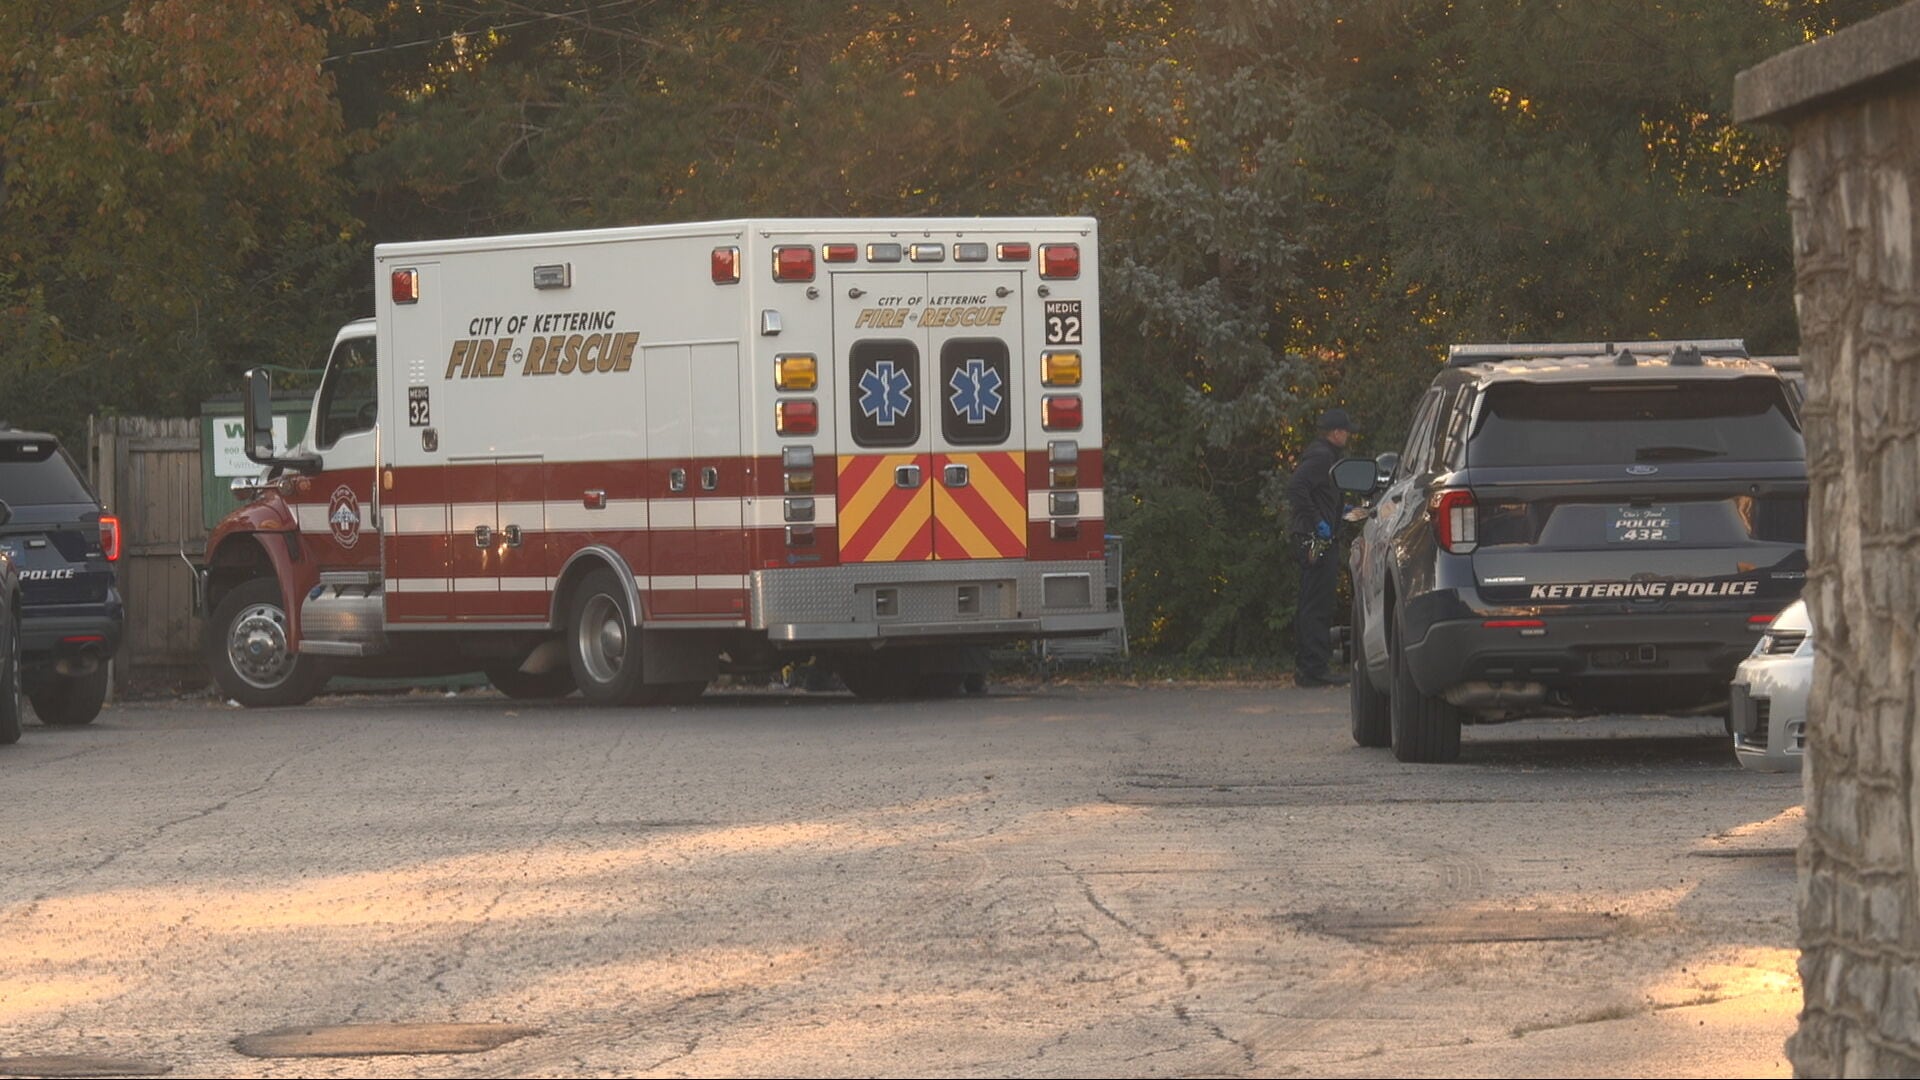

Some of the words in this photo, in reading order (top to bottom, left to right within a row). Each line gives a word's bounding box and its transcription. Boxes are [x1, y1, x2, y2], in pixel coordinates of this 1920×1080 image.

[878, 297, 903, 306] CITY
[907, 296, 923, 306] OF
[1047, 303, 1079, 313] MEDIC
[469, 316, 503, 336] CITY
[507, 315, 528, 335] OF
[533, 311, 616, 333] KETTERING
[855, 308, 910, 329] FIRE
[917, 306, 1007, 328] RESCUE
[1048, 316, 1080, 343] 32
[445, 338, 514, 380] FIRE
[522, 331, 640, 377] RESCUE
[411, 401, 429, 424] 32
[1615, 519, 1670, 529] POLICE
[1624, 529, 1663, 540] 432
[19, 568, 74, 580] POLICE
[1530, 583, 1666, 599] KETTERING
[1670, 581, 1759, 597] POLICE
